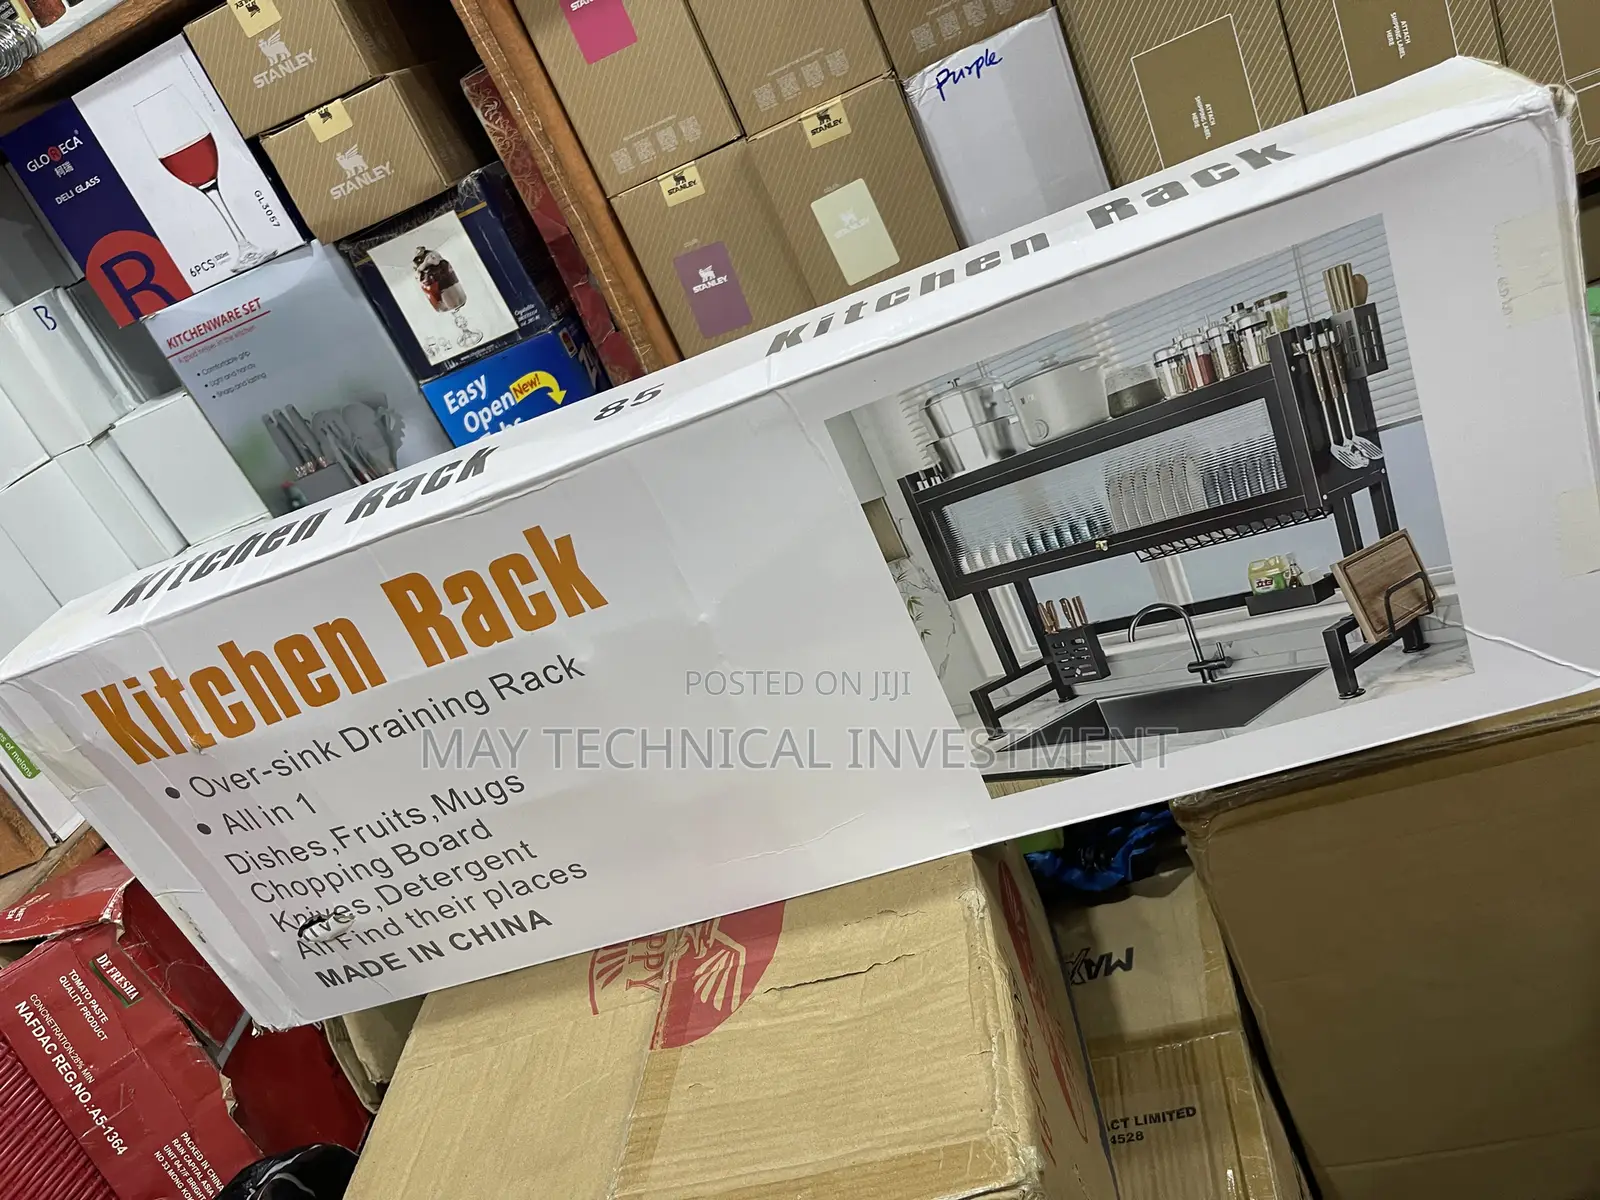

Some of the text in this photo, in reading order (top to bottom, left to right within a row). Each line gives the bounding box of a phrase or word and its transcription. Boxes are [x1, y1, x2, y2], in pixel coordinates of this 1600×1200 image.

[1400, 20, 1411, 44] ATTACH
[252, 47, 315, 89] STANLEY
[936, 48, 1003, 101] Purple
[810, 117, 843, 136] STANLEY
[1205, 103, 1216, 126] ATTACH
[55, 175, 101, 205] DELI GLASS
[330, 161, 391, 200] STANLEY
[667, 179, 698, 196] STANLEY
[189, 259, 216, 278] 6PCS
[765, 142, 1296, 357] Kitchen Rack
[100, 250, 176, 320] R
[692, 274, 728, 294] STANLEY
[166, 297, 262, 350] KITCHENWARE SET
[443, 374, 487, 415] Easy
[512, 373, 541, 399] New!
[593, 383, 665, 421] 85
[463, 390, 518, 433] Open
[107, 445, 500, 615] Kitchen Rack
[81, 524, 609, 765] Kitchen Rack
[188, 652, 586, 800] Over-sink Draining Rack
[5, 742, 15, 751] of
[11, 751, 33, 777] melons
[221, 791, 318, 837] All in 1
[250, 817, 494, 905] Chopping Board
[335, 916, 408, 951] Find
[404, 890, 478, 930] their
[480, 858, 589, 909] places
[314, 908, 553, 989] MADE IN CHINA
[68, 969, 109, 1024] TOMATO PASTE
[96, 953, 140, 1000] DE FRESHA
[15, 1000, 58, 1055] NAFDAC
[59, 975, 109, 1041] QUALITY PRODUCT
[81, 1067, 95, 1084] MIN
[1134, 1105, 1198, 1127] LIMITED
[163, 1144, 178, 1160] UNIT
[1110, 1130, 1145, 1145] 4528
[153, 1150, 165, 1162] NO
[161, 1160, 171, 1170] 33
[167, 1168, 185, 1189] MONG
[171, 1138, 215, 1197] RAIN CAPITAL ASIA
[180, 1131, 225, 1192] PACKED IN CHINA
